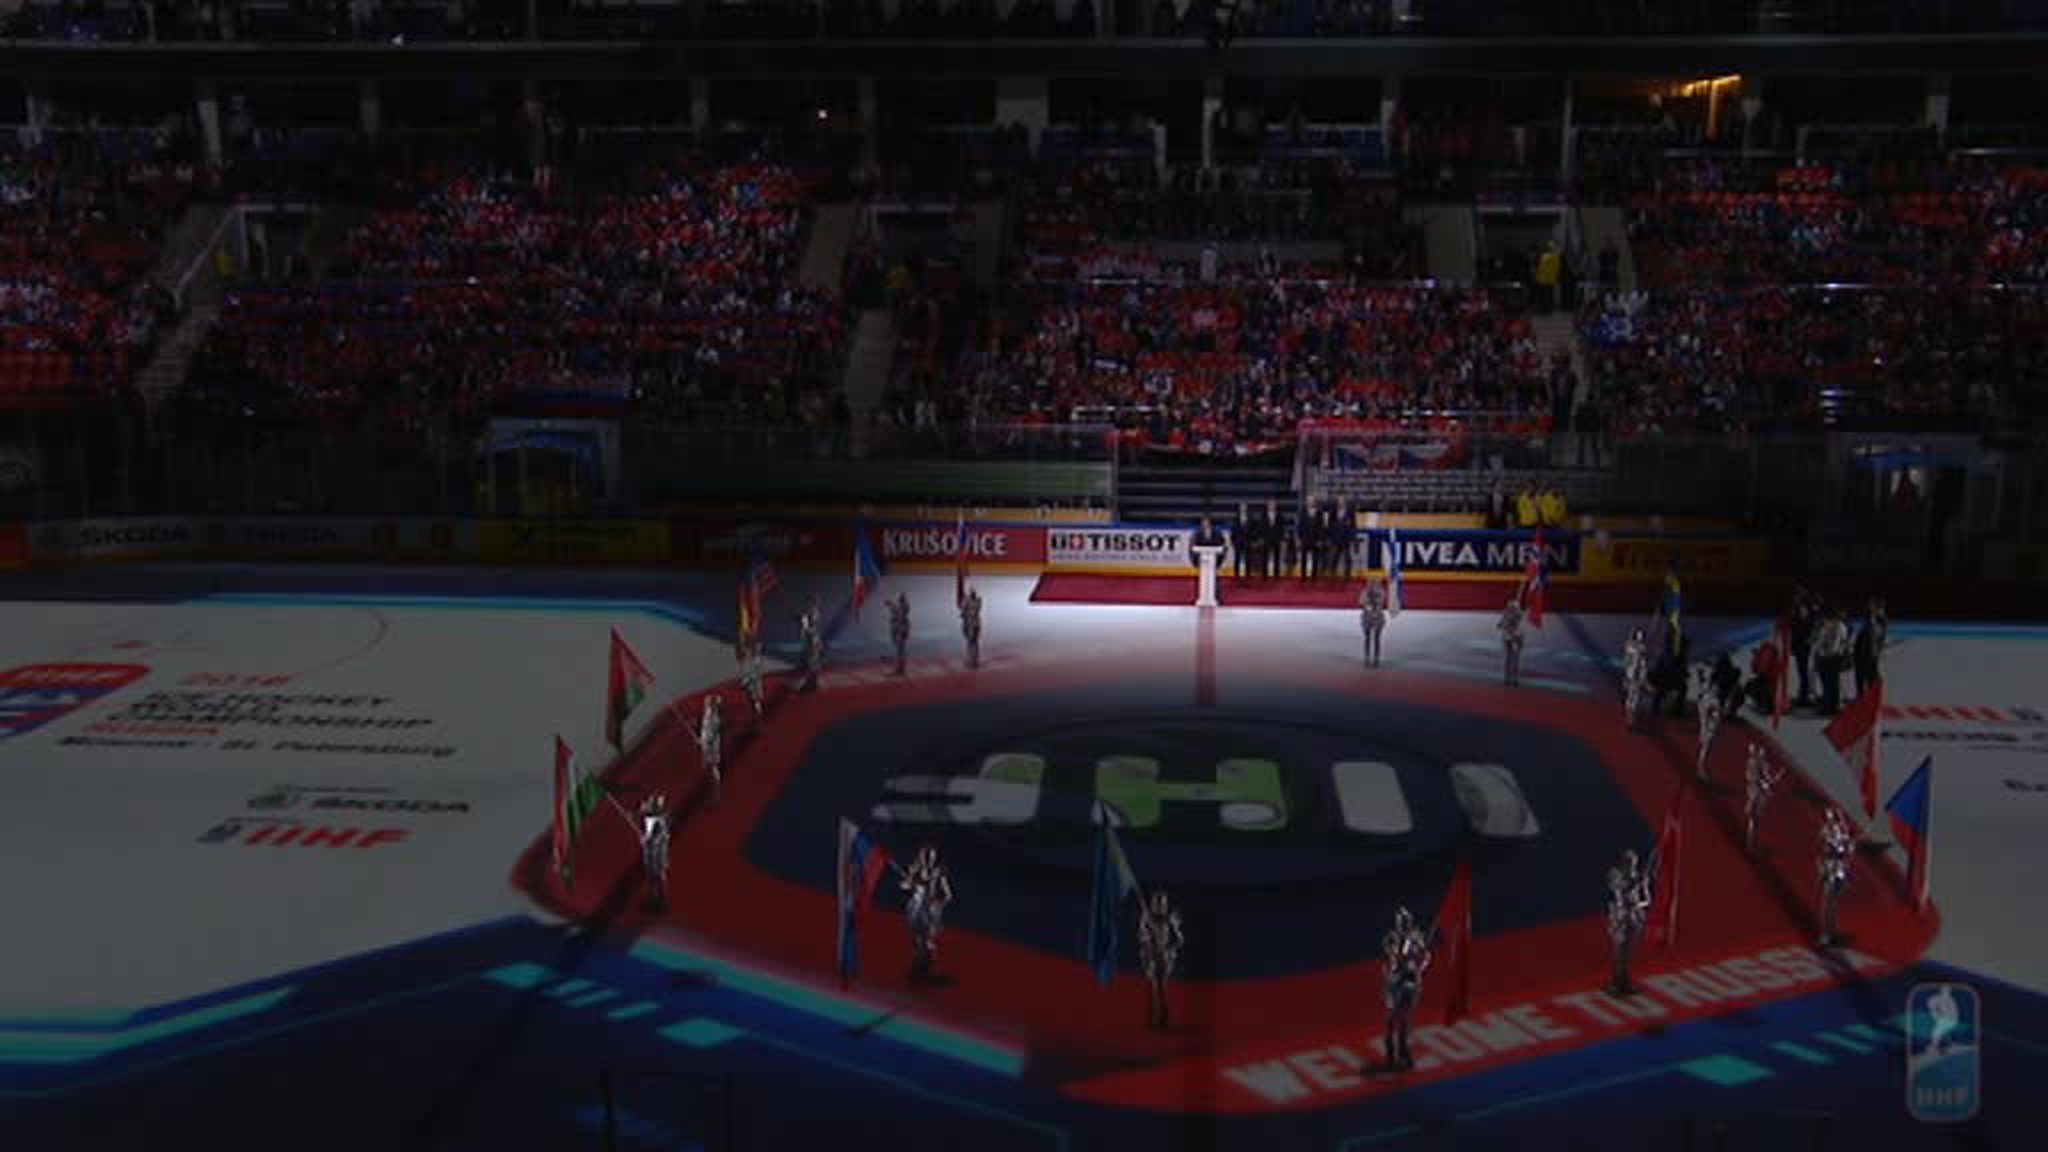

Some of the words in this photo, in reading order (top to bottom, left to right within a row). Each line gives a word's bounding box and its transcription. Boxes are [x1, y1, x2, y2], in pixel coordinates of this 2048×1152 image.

[1088, 534, 1180, 551] TISSOT
[1380, 541, 1479, 567] NIVEA
[243, 823, 411, 848] IIHF
